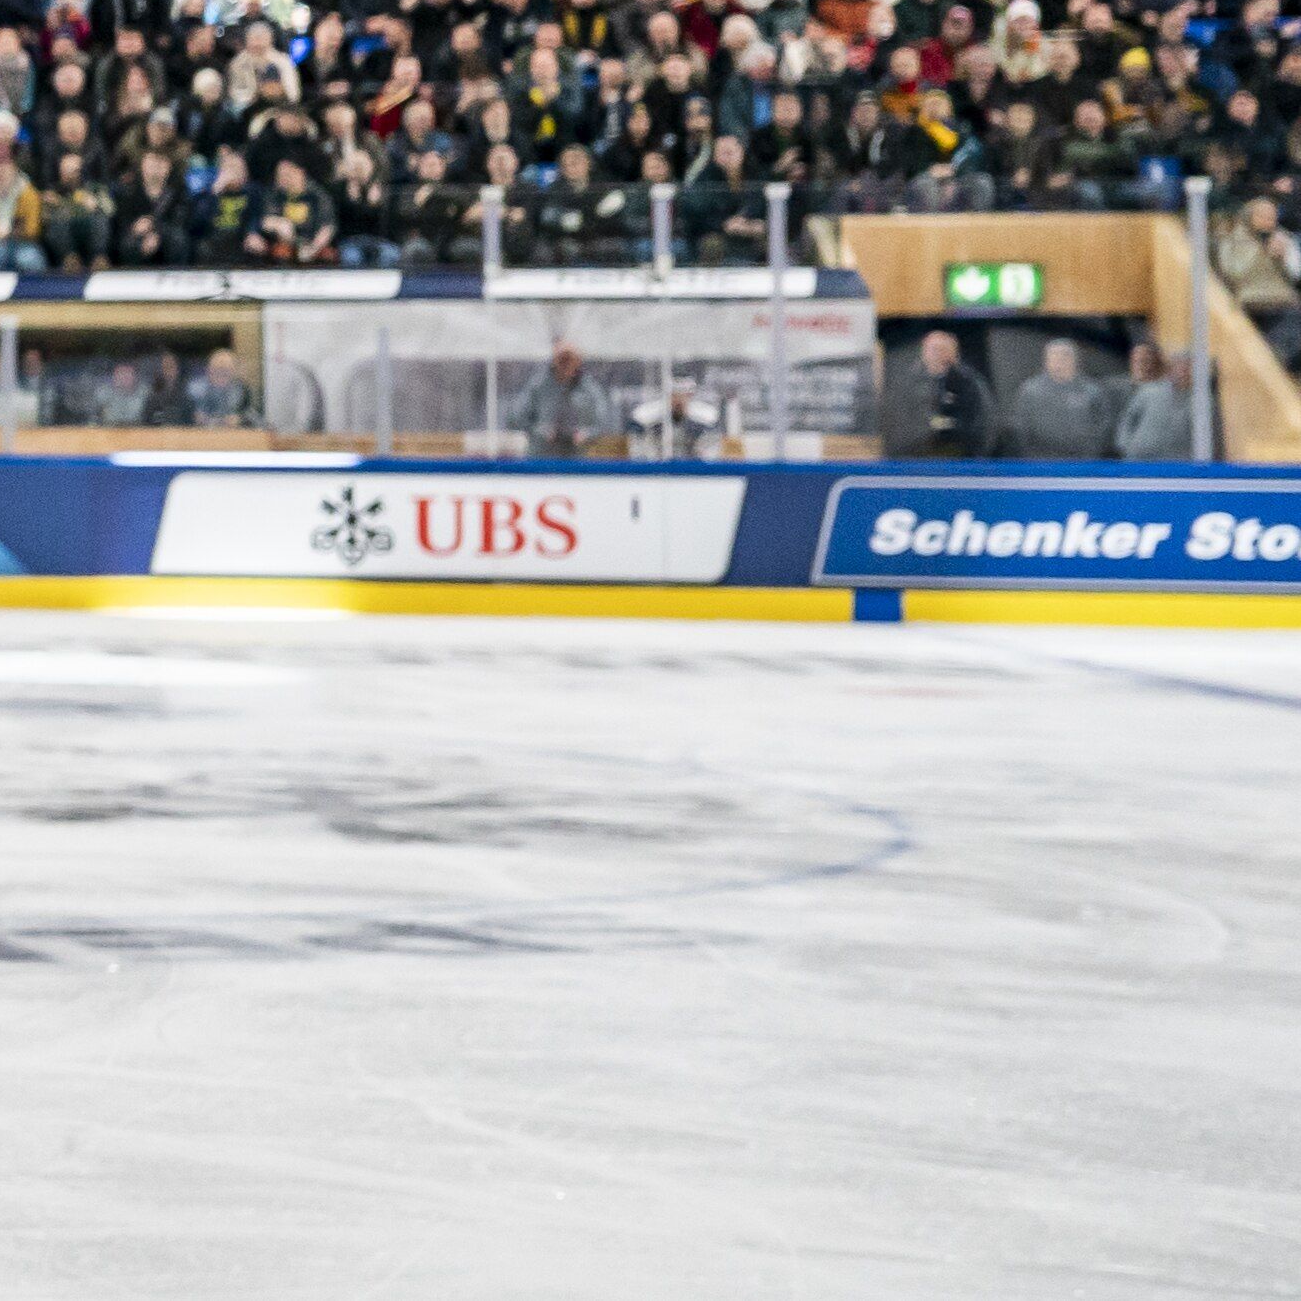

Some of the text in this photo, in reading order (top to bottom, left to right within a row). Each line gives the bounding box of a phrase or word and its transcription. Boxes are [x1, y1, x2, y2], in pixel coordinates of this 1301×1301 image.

[415, 498, 579, 557] UBS
[869, 508, 1301, 561] Schenker Sto
